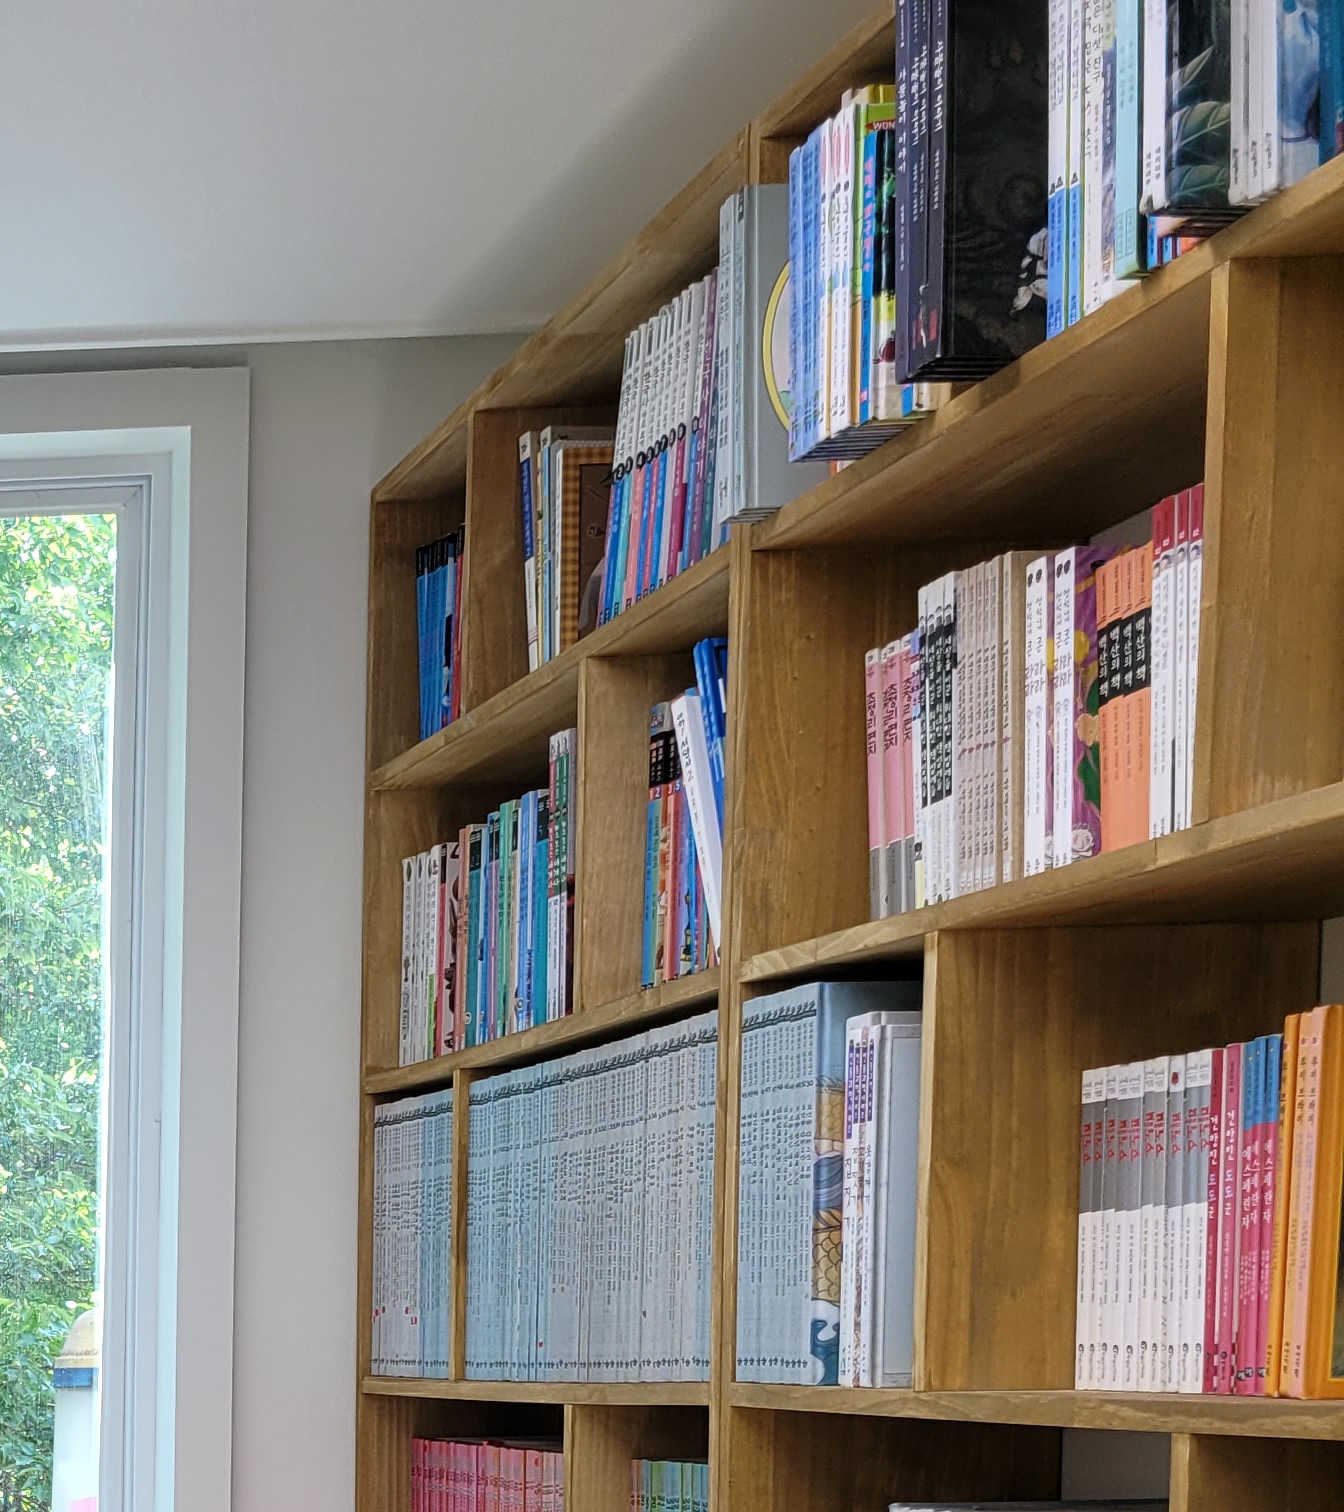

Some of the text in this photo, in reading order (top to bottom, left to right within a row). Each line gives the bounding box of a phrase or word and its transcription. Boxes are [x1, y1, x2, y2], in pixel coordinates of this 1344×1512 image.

[1093, 57, 1101, 82] 친구
[1110, 672, 1120, 690] 책
[1123, 670, 1132, 687] 책
[1135, 663, 1146, 682] 책
[1099, 681, 1108, 698] 책
